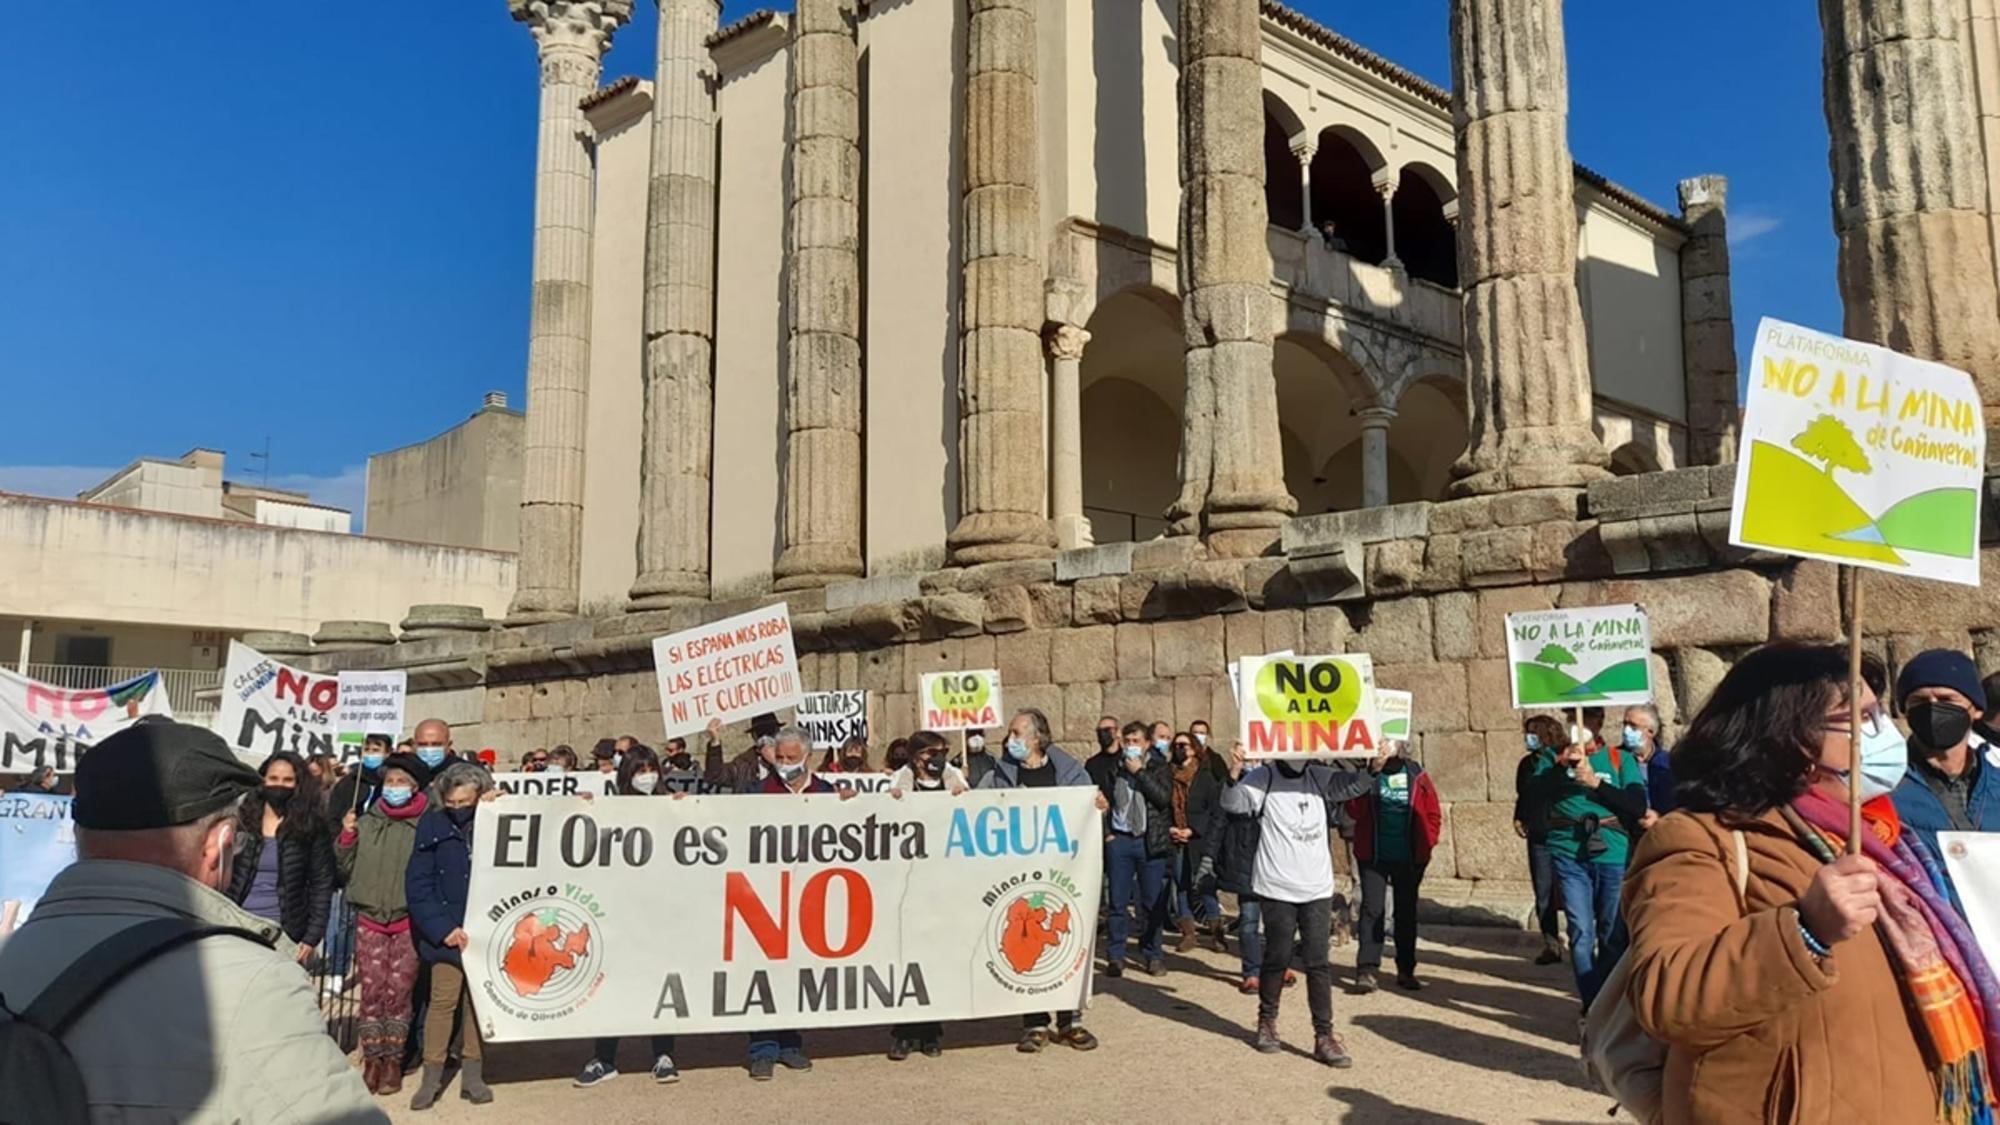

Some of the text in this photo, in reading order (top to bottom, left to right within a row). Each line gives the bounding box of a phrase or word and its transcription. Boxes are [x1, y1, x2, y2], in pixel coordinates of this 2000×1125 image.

[1767, 328, 1870, 367] PLATAFORMA
[1763, 355, 1975, 436] NO A LA MINA
[1866, 422, 1978, 469] de Cañaveral
[669, 616, 789, 663] SI ESPAÑA NOS ROBA
[1513, 617, 1641, 641] NO A LA MINA
[1572, 641, 1585, 653] de
[275, 667, 338, 711] NO
[667, 645, 784, 695] LAS ELÉCTRICAS
[942, 674, 979, 694] NO
[1274, 662, 1341, 694] NO
[26, 681, 109, 721] NO
[288, 707, 329, 724] A LAS
[671, 700, 688, 724] NI
[692, 693, 712, 718] TE
[928, 706, 997, 728] MINA
[949, 695, 974, 704] A LA
[1287, 699, 1332, 713] A LA
[1248, 719, 1374, 752] MINA
[493, 804, 1079, 868] El Oro es nuestra AGUA,
[488, 883, 606, 922] Minas o Vidas
[982, 868, 1082, 907] Minas o Vidas
[723, 867, 874, 962] NO
[653, 962, 931, 1019] A LA MINA
